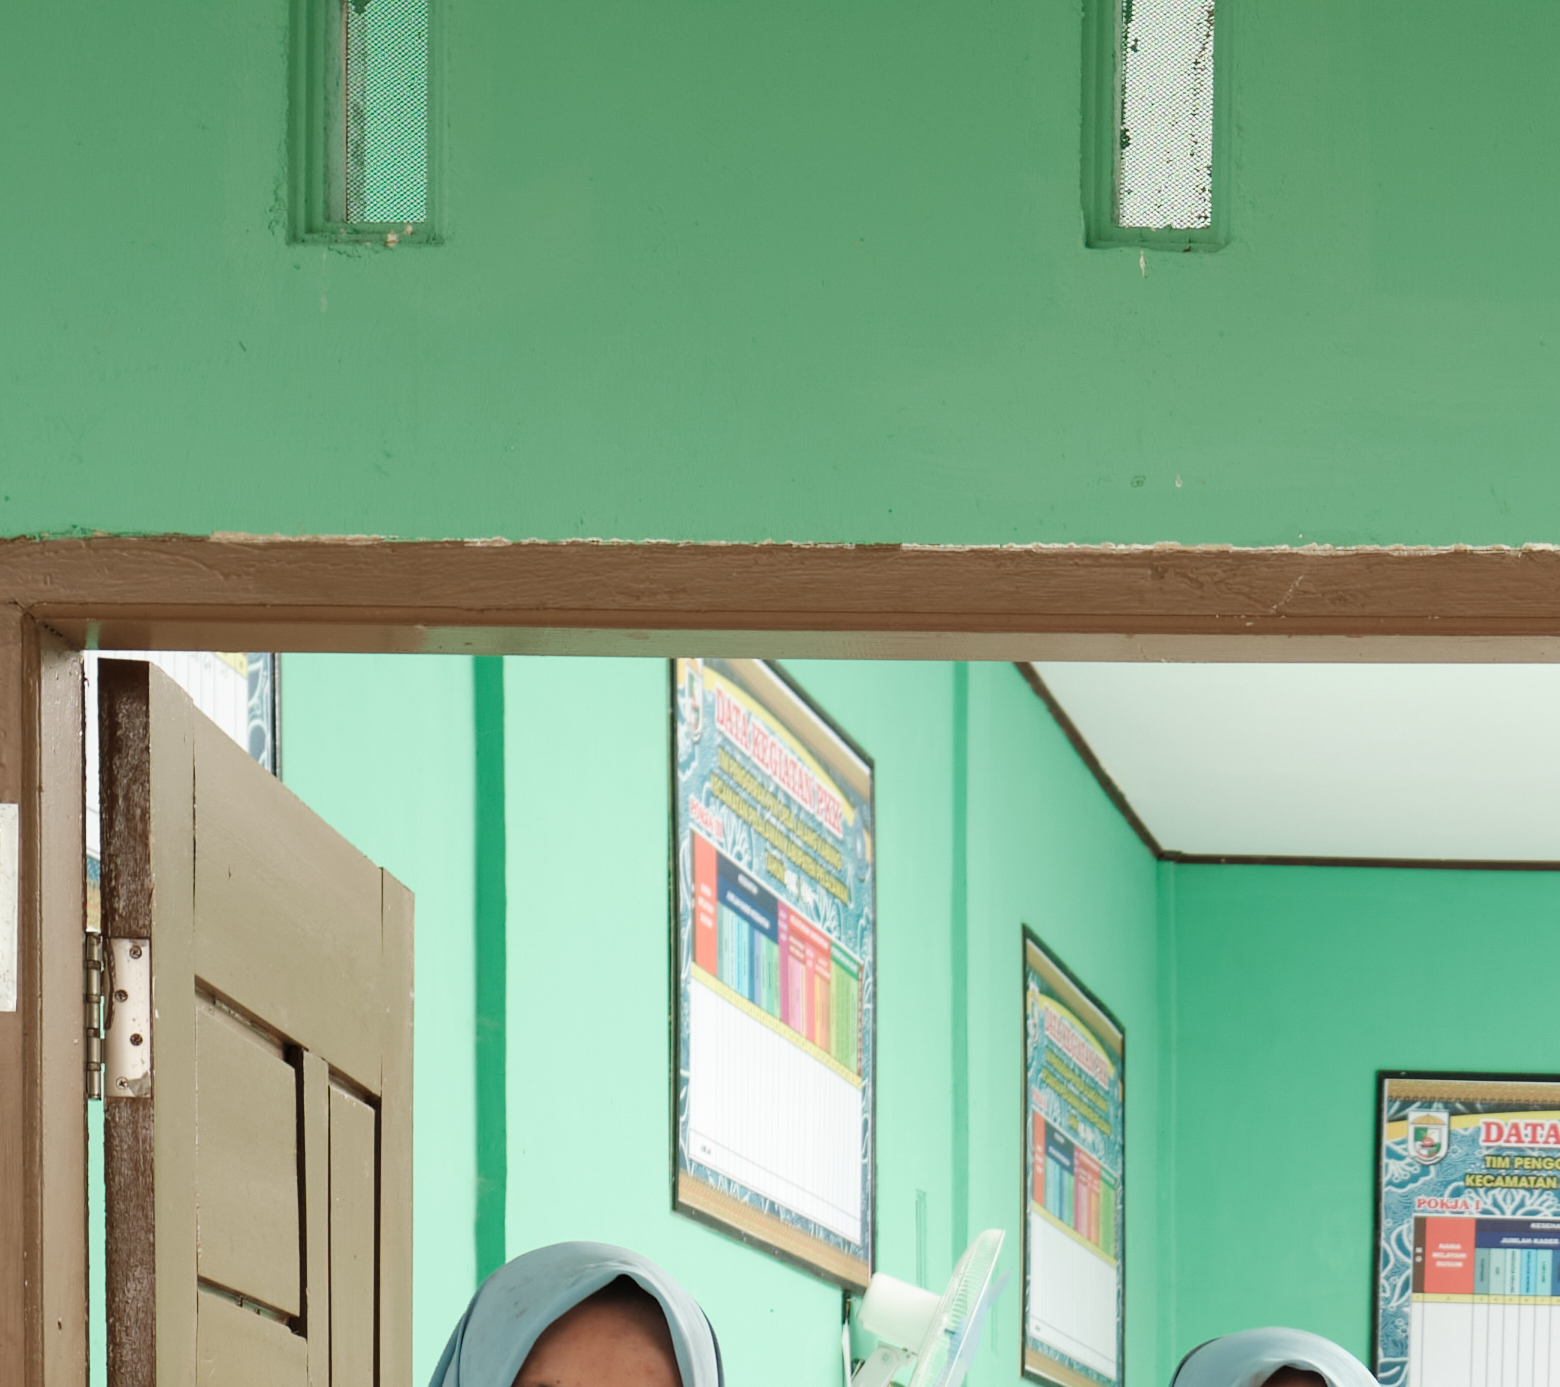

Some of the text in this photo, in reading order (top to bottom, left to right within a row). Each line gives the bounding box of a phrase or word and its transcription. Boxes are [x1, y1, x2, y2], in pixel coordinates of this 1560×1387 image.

[1484, 1155, 1511, 1169] TIM
[1465, 1173, 1558, 1190] KECAMATAN
[1416, 1197, 1470, 1211] POKJA
